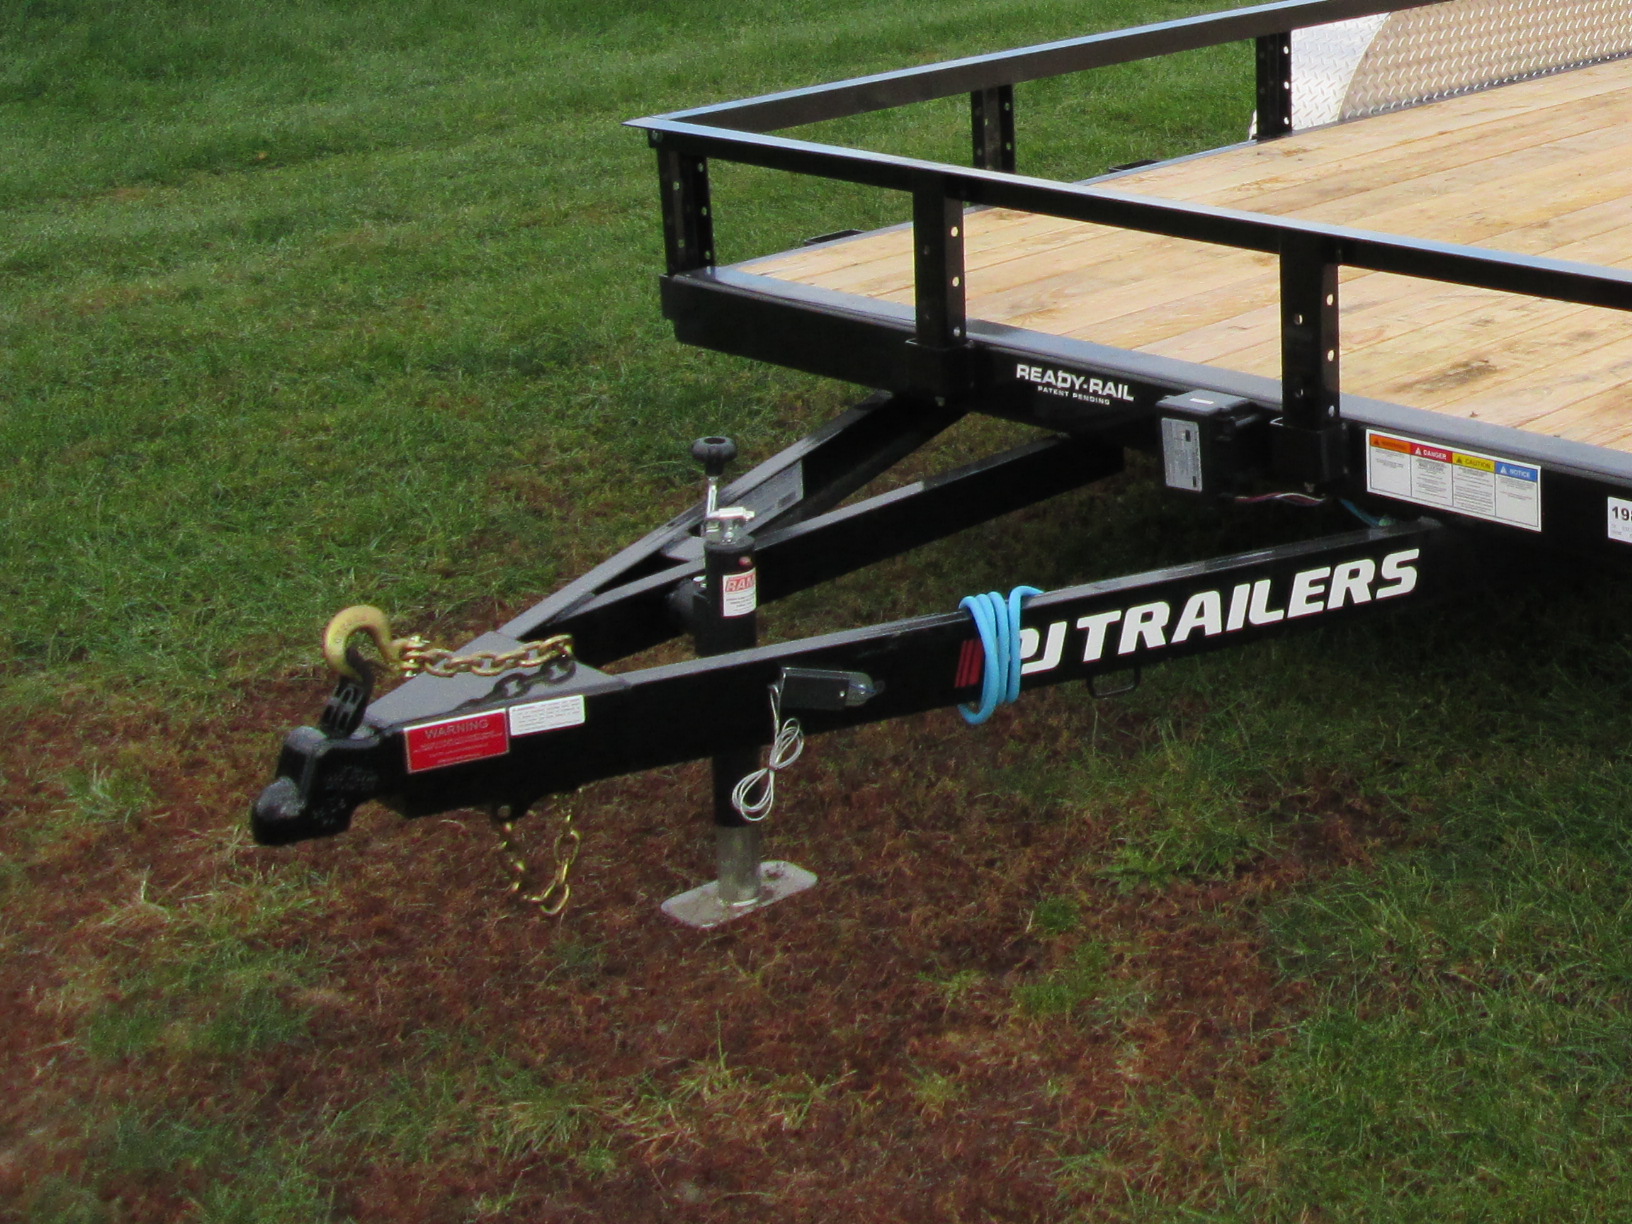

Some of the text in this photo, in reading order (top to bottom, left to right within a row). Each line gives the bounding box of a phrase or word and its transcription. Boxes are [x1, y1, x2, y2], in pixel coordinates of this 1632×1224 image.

[1016, 363, 1135, 402] READY-RAIL
[1037, 385, 1111, 406] PATENT PENDING
[1423, 448, 1447, 460] DANGER
[1464, 458, 1491, 469] CAUTION
[1509, 468, 1531, 478] NOTICE
[1077, 548, 1420, 663] TRAILERS
[425, 718, 490, 740] WARNING
